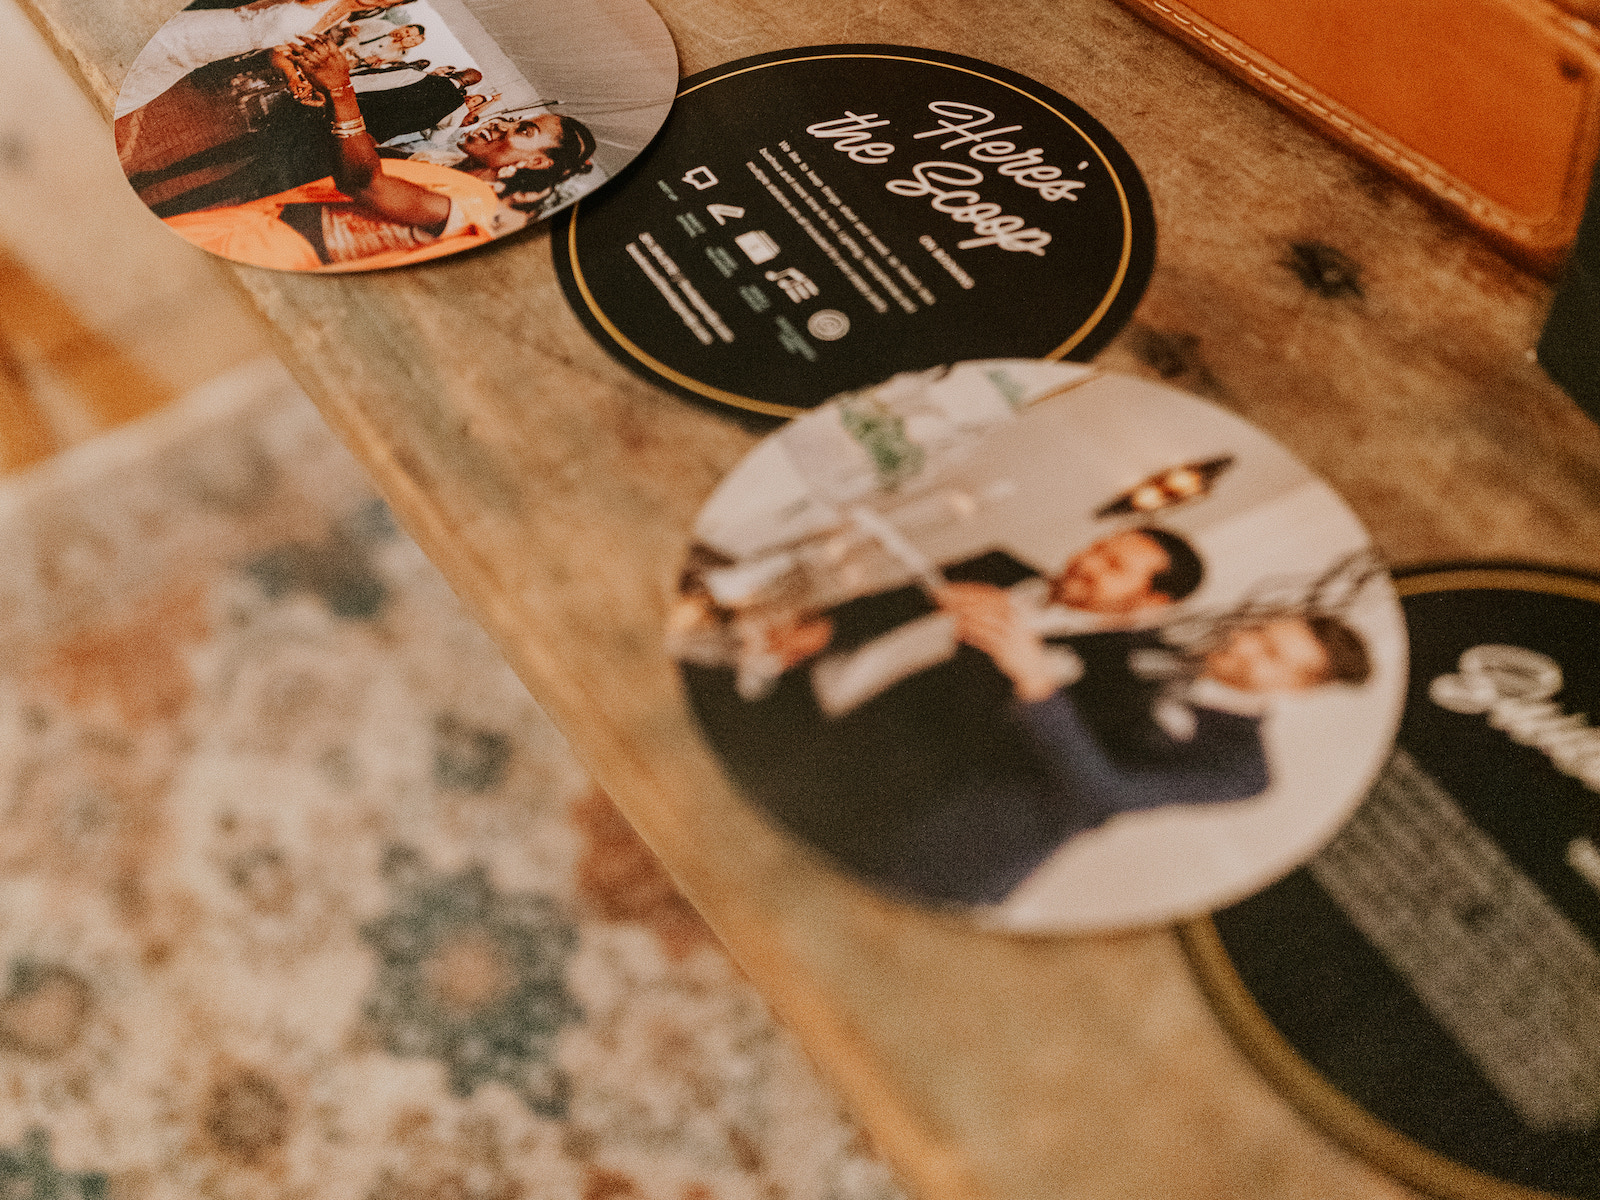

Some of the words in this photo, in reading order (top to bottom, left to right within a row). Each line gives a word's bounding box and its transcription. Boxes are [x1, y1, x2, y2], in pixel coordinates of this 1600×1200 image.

[805, 110, 896, 165] the
[885, 160, 1053, 258] Scoop
[913, 100, 1089, 202] Here's
